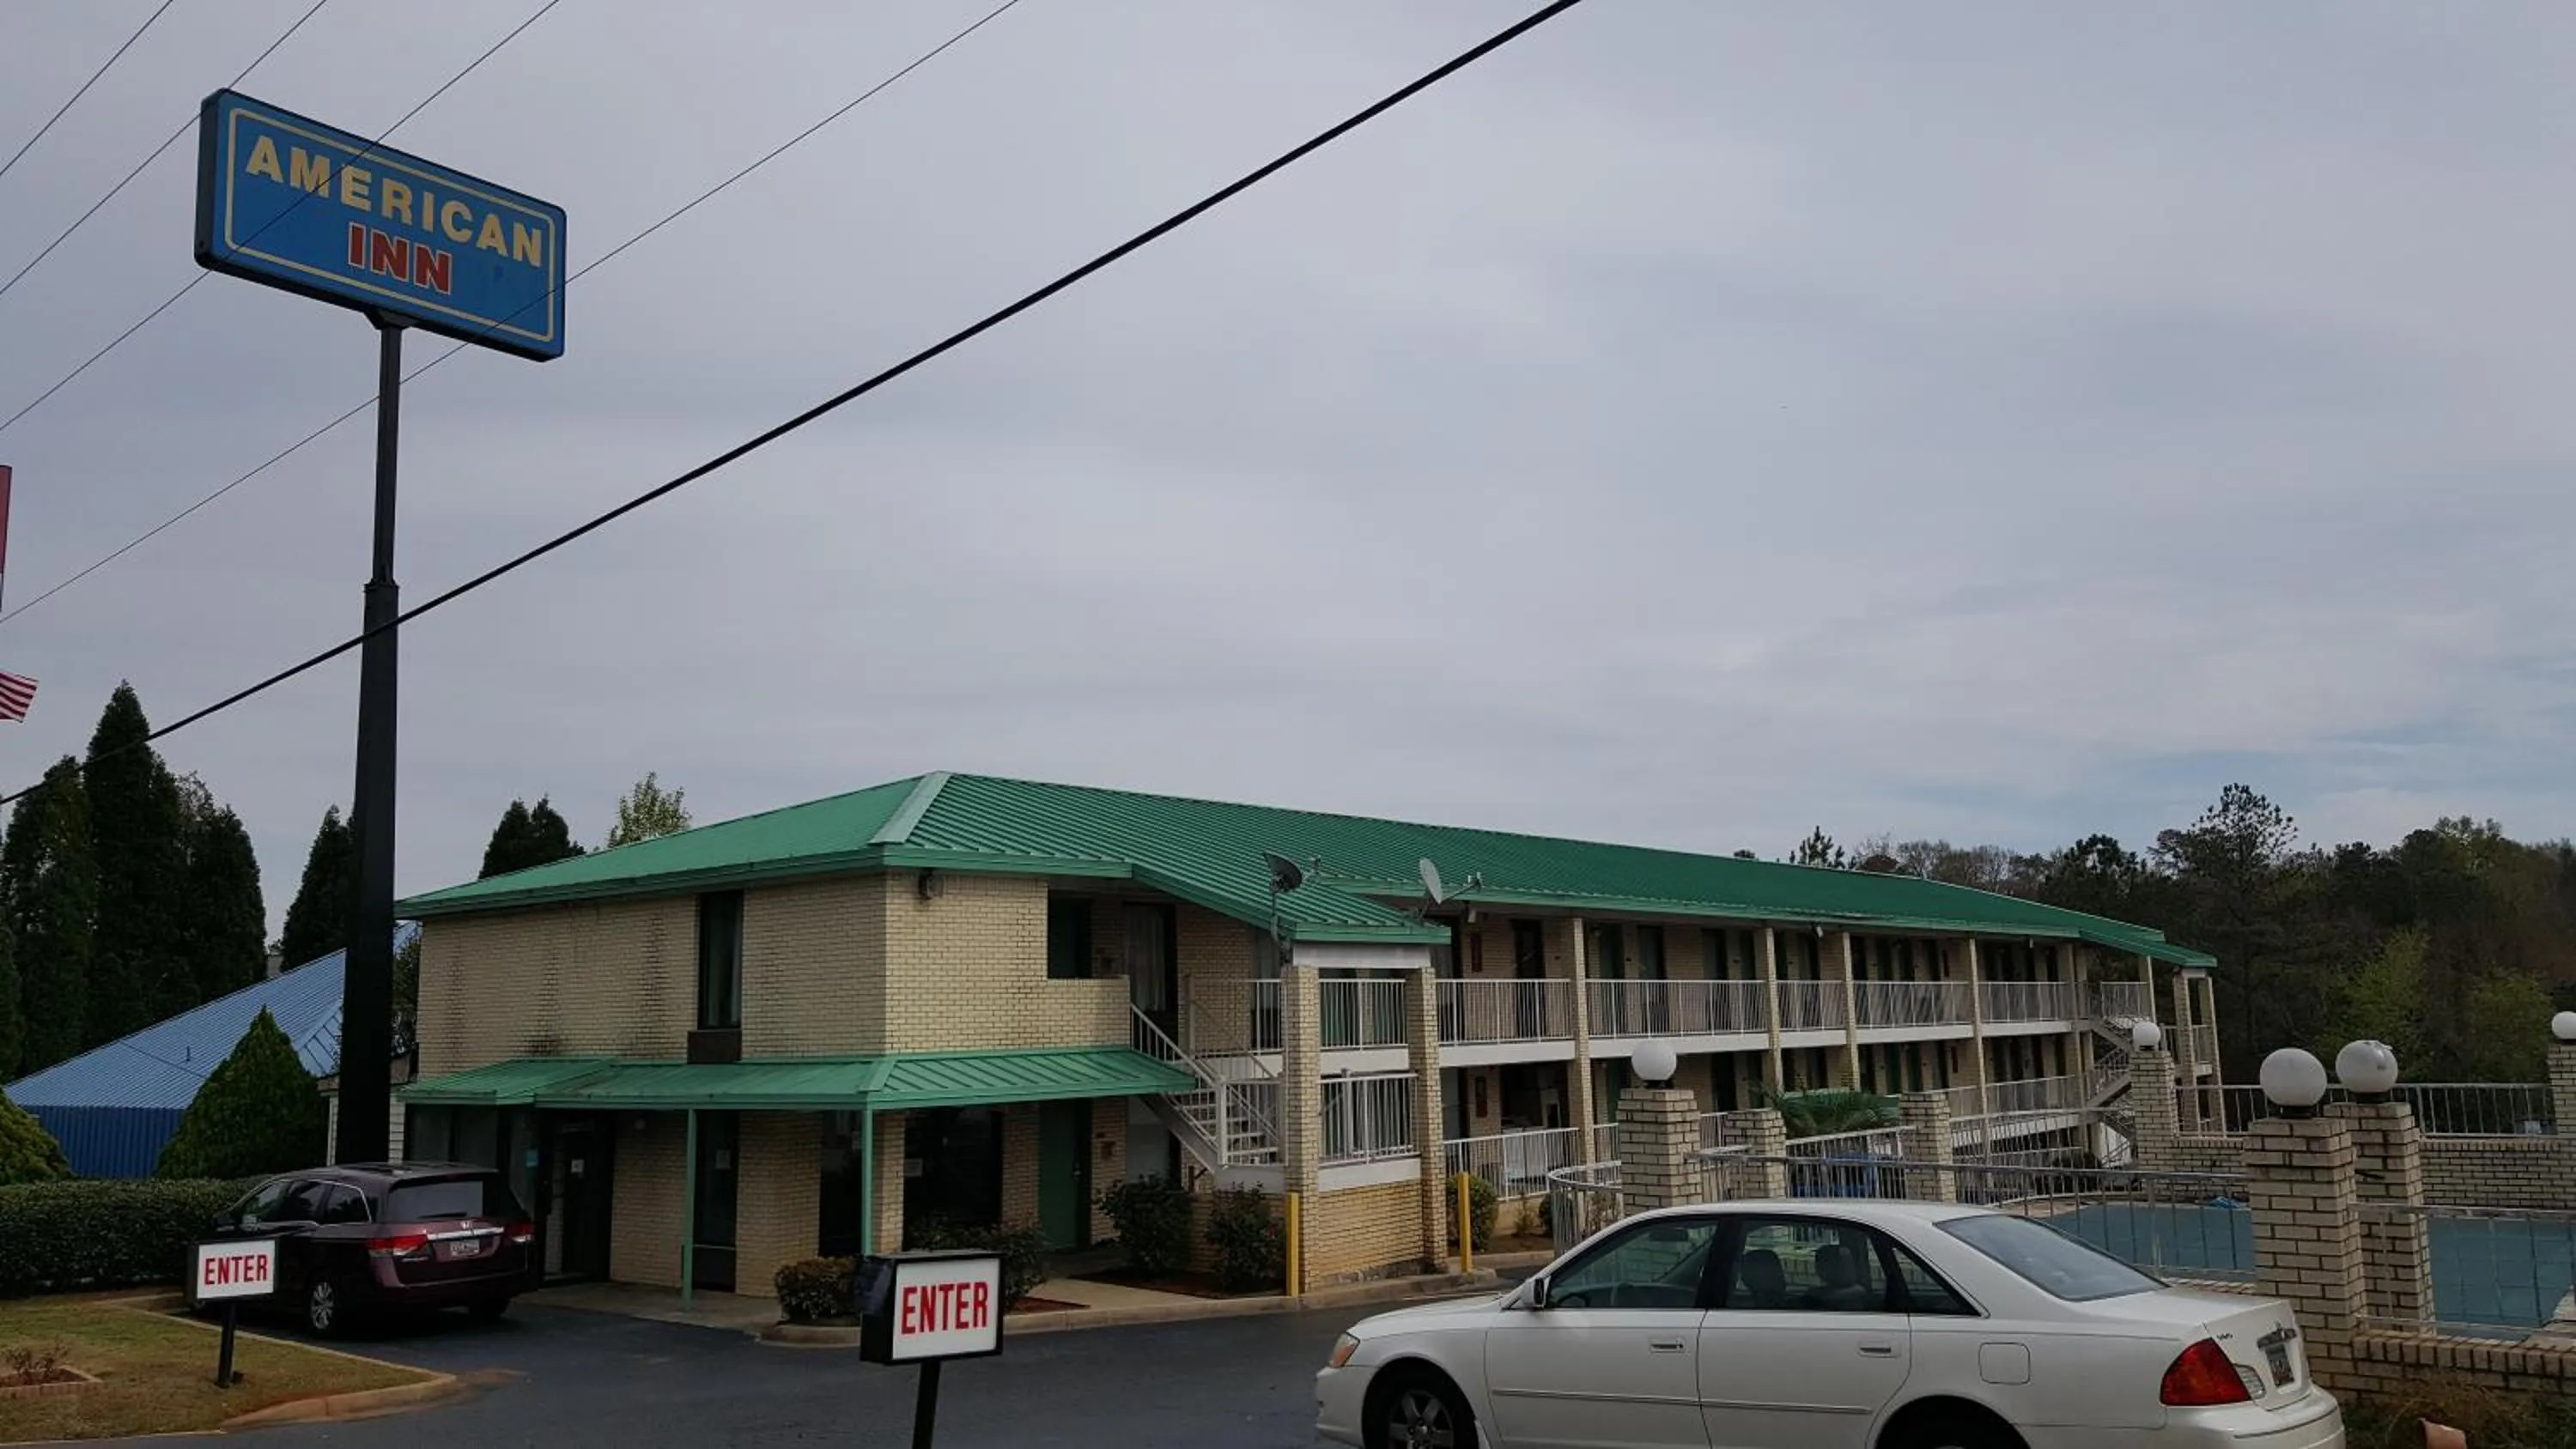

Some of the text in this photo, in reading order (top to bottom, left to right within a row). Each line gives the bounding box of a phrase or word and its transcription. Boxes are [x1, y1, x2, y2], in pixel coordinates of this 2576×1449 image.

[246, 135, 543, 268] AMERICAN
[348, 221, 453, 295] INN
[204, 1254, 269, 1285] ENTER
[902, 1281, 988, 1334] ENTER
